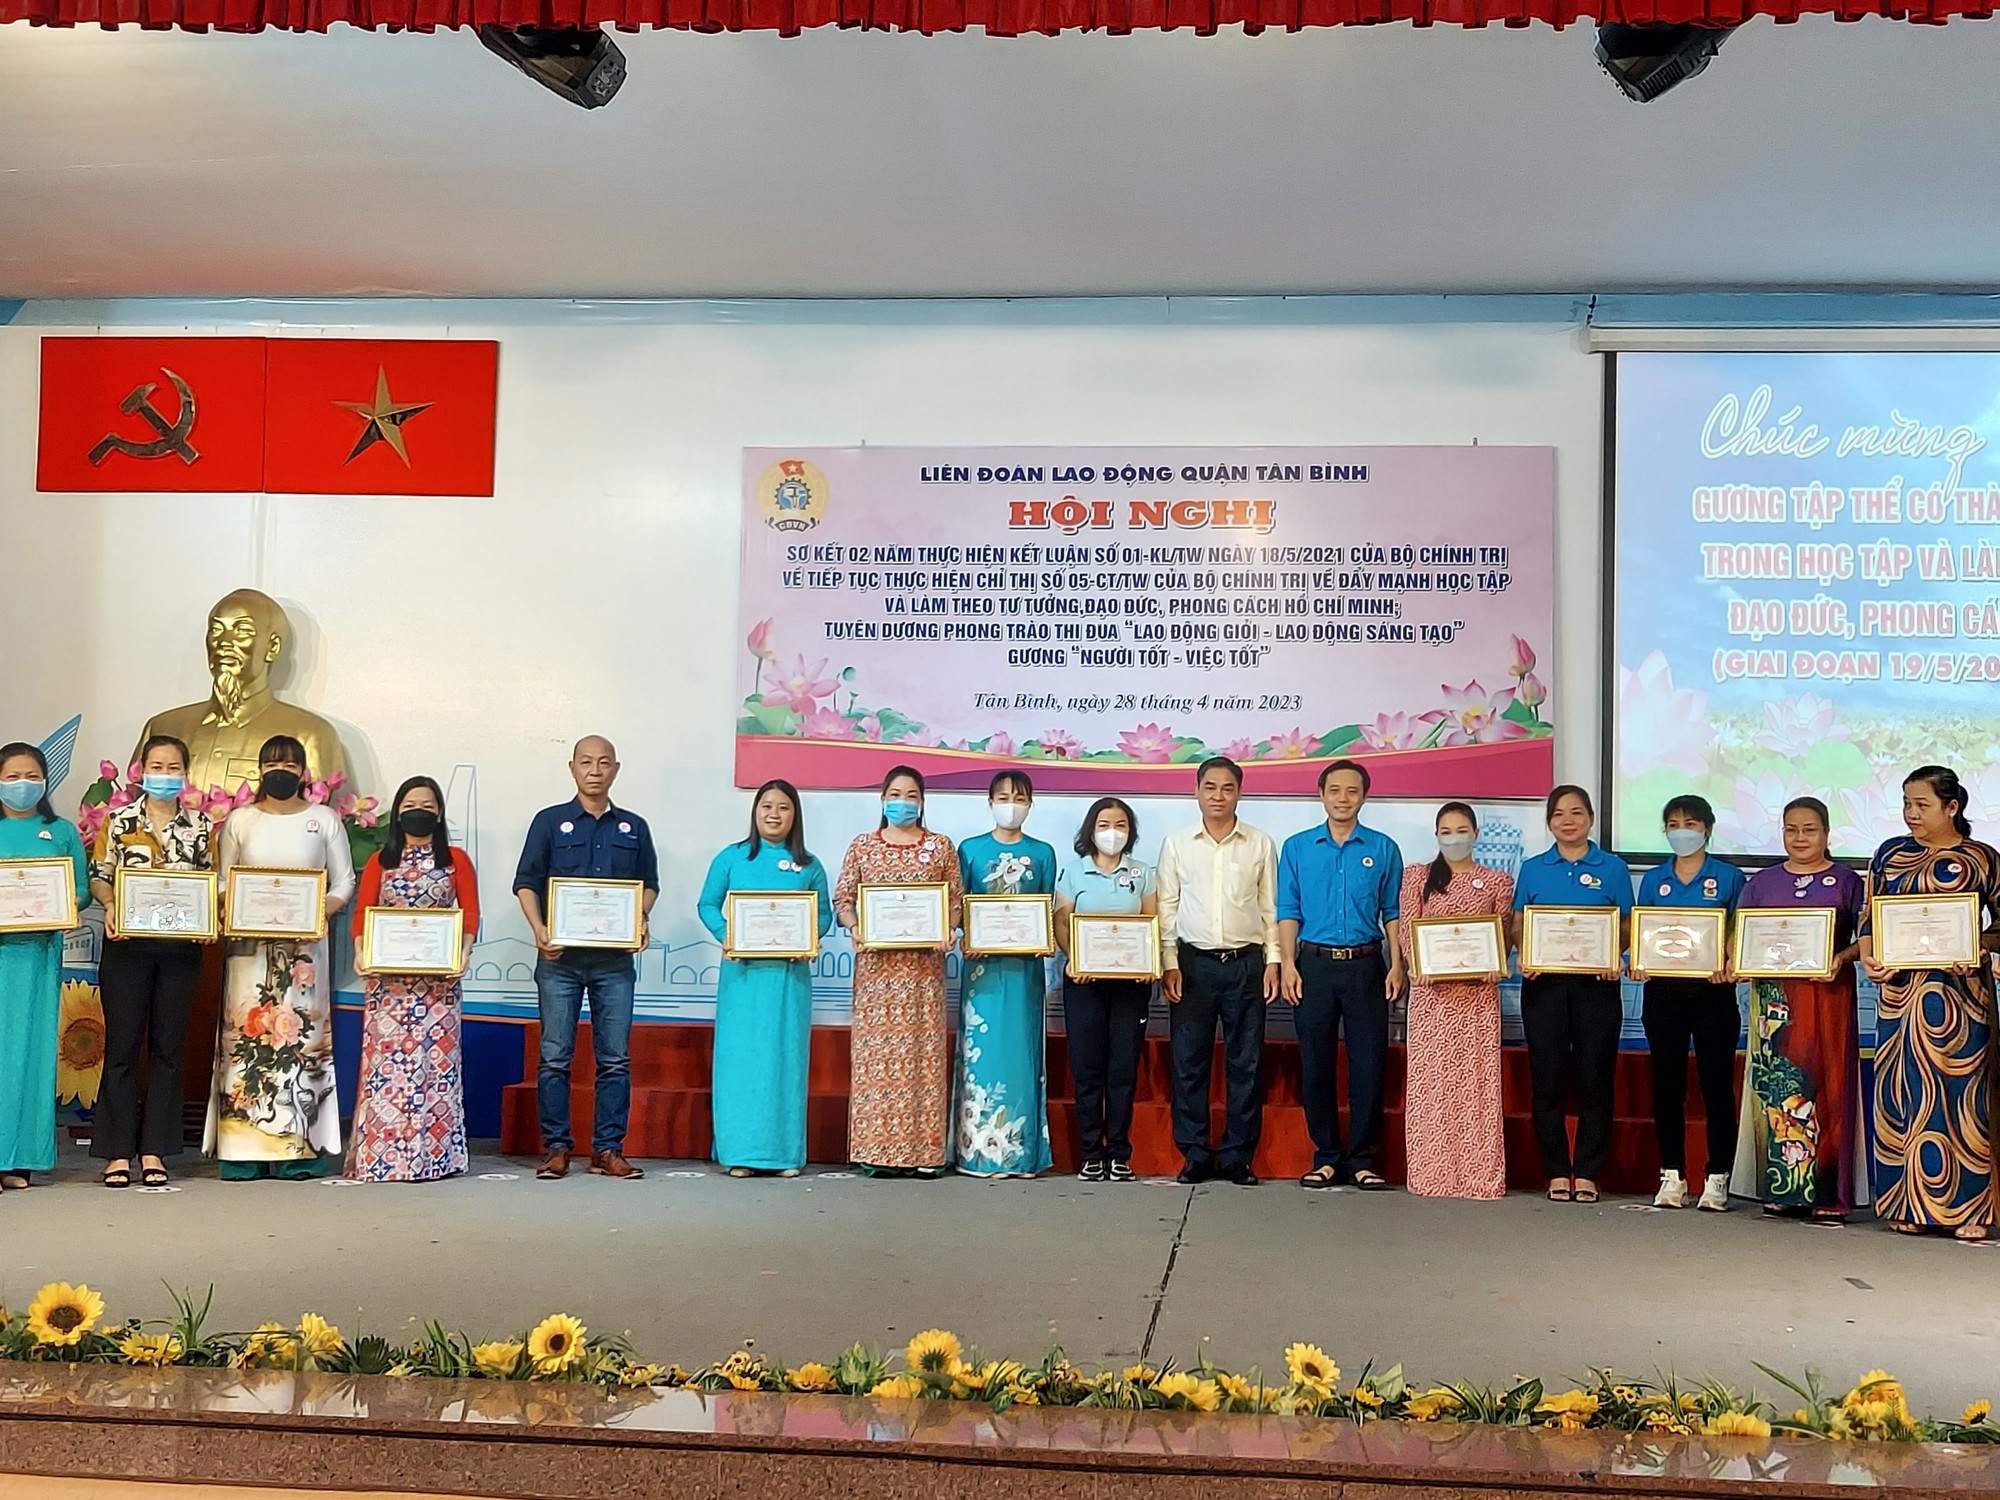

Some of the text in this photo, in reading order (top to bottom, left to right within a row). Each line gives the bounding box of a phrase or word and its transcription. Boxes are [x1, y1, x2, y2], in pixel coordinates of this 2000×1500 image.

[1701, 384, 1986, 503] Chúc mừng
[921, 462, 1367, 486] LIÊN ĐOÀN LAO ĐỘNG QUẬN TÂN BÌNH
[1009, 495, 1273, 532] HỘI NGHỊ
[1694, 484, 1785, 521] GƯƠNG
[1791, 481, 1844, 529] TẬP
[1850, 475, 1902, 523] THỂ
[1908, 483, 1945, 523] CÓ
[787, 542, 1506, 566] SƠ KẾT 02 NĂM THỰC HIỆN KẾT LUẬN SỐ 01-KL/TW NGÀY 18/5/2021 CỦA BỘ CHÍNH TRỊ
[1702, 538, 2000, 586] TRONG HỌC TẬP VÀ LÀ
[808, 567, 842, 587] TIẾP
[848, 572, 879, 591] TỤC
[885, 571, 926, 591] THỰC
[932, 570, 970, 591] HIỆN
[976, 568, 1006, 588] CHỈ
[1009, 572, 1035, 592] THỊ
[1041, 567, 1067, 588] SỐ
[1068, 572, 1148, 589] 05-CT/TW
[1154, 568, 1188, 588] CỦA
[1193, 570, 1216, 592] BỘ
[1222, 569, 1274, 588] CHÍNH
[1280, 572, 1306, 592] TRỊ
[1339, 567, 1372, 589] ĐẨY
[1378, 573, 1430, 593] MẠNH
[1436, 573, 1471, 593] HỌC
[1477, 570, 1510, 593] TẬP
[885, 594, 906, 613] VÀ
[911, 594, 946, 613] LÀM
[951, 598, 993, 614] THEO
[998, 597, 1021, 614] TƯ
[1124, 595, 1163, 616] ĐỨC,
[1169, 598, 1227, 614] PHONG
[1233, 595, 1278, 614] CÁCH
[1284, 593, 1307, 614] HỒ
[1313, 595, 1344, 614] CHÍ
[1348, 598, 1400, 617] MINH;
[1729, 599, 1784, 640] ĐẠO
[1790, 594, 1855, 640] ĐỨC,
[1861, 601, 1955, 636] PHONG
[824, 619, 876, 638] TUYÊN
[882, 621, 938, 639] DƯƠNG
[944, 623, 1000, 639] PHONG
[1006, 620, 1049, 639] TRÀO
[1054, 623, 1080, 639] THI
[1085, 623, 1118, 640] ĐUA
[1170, 621, 1217, 643] ĐỘNG
[1223, 619, 1257, 640] GIỎI
[1275, 624, 1307, 640] LAO
[1312, 621, 1360, 643] ĐỘNG
[1366, 621, 1413, 641] SÁNG
[1008, 647, 1065, 665] GƯƠNG
[1138, 644, 1169, 665] TỐT
[1185, 646, 1223, 669] VIỆC
[1713, 648, 1786, 681] (GIAI
[1793, 651, 1880, 684] ĐOẠN
[974, 693, 1302, 713] Tân Bình, ngày 28 tháng 4 năm 2023
